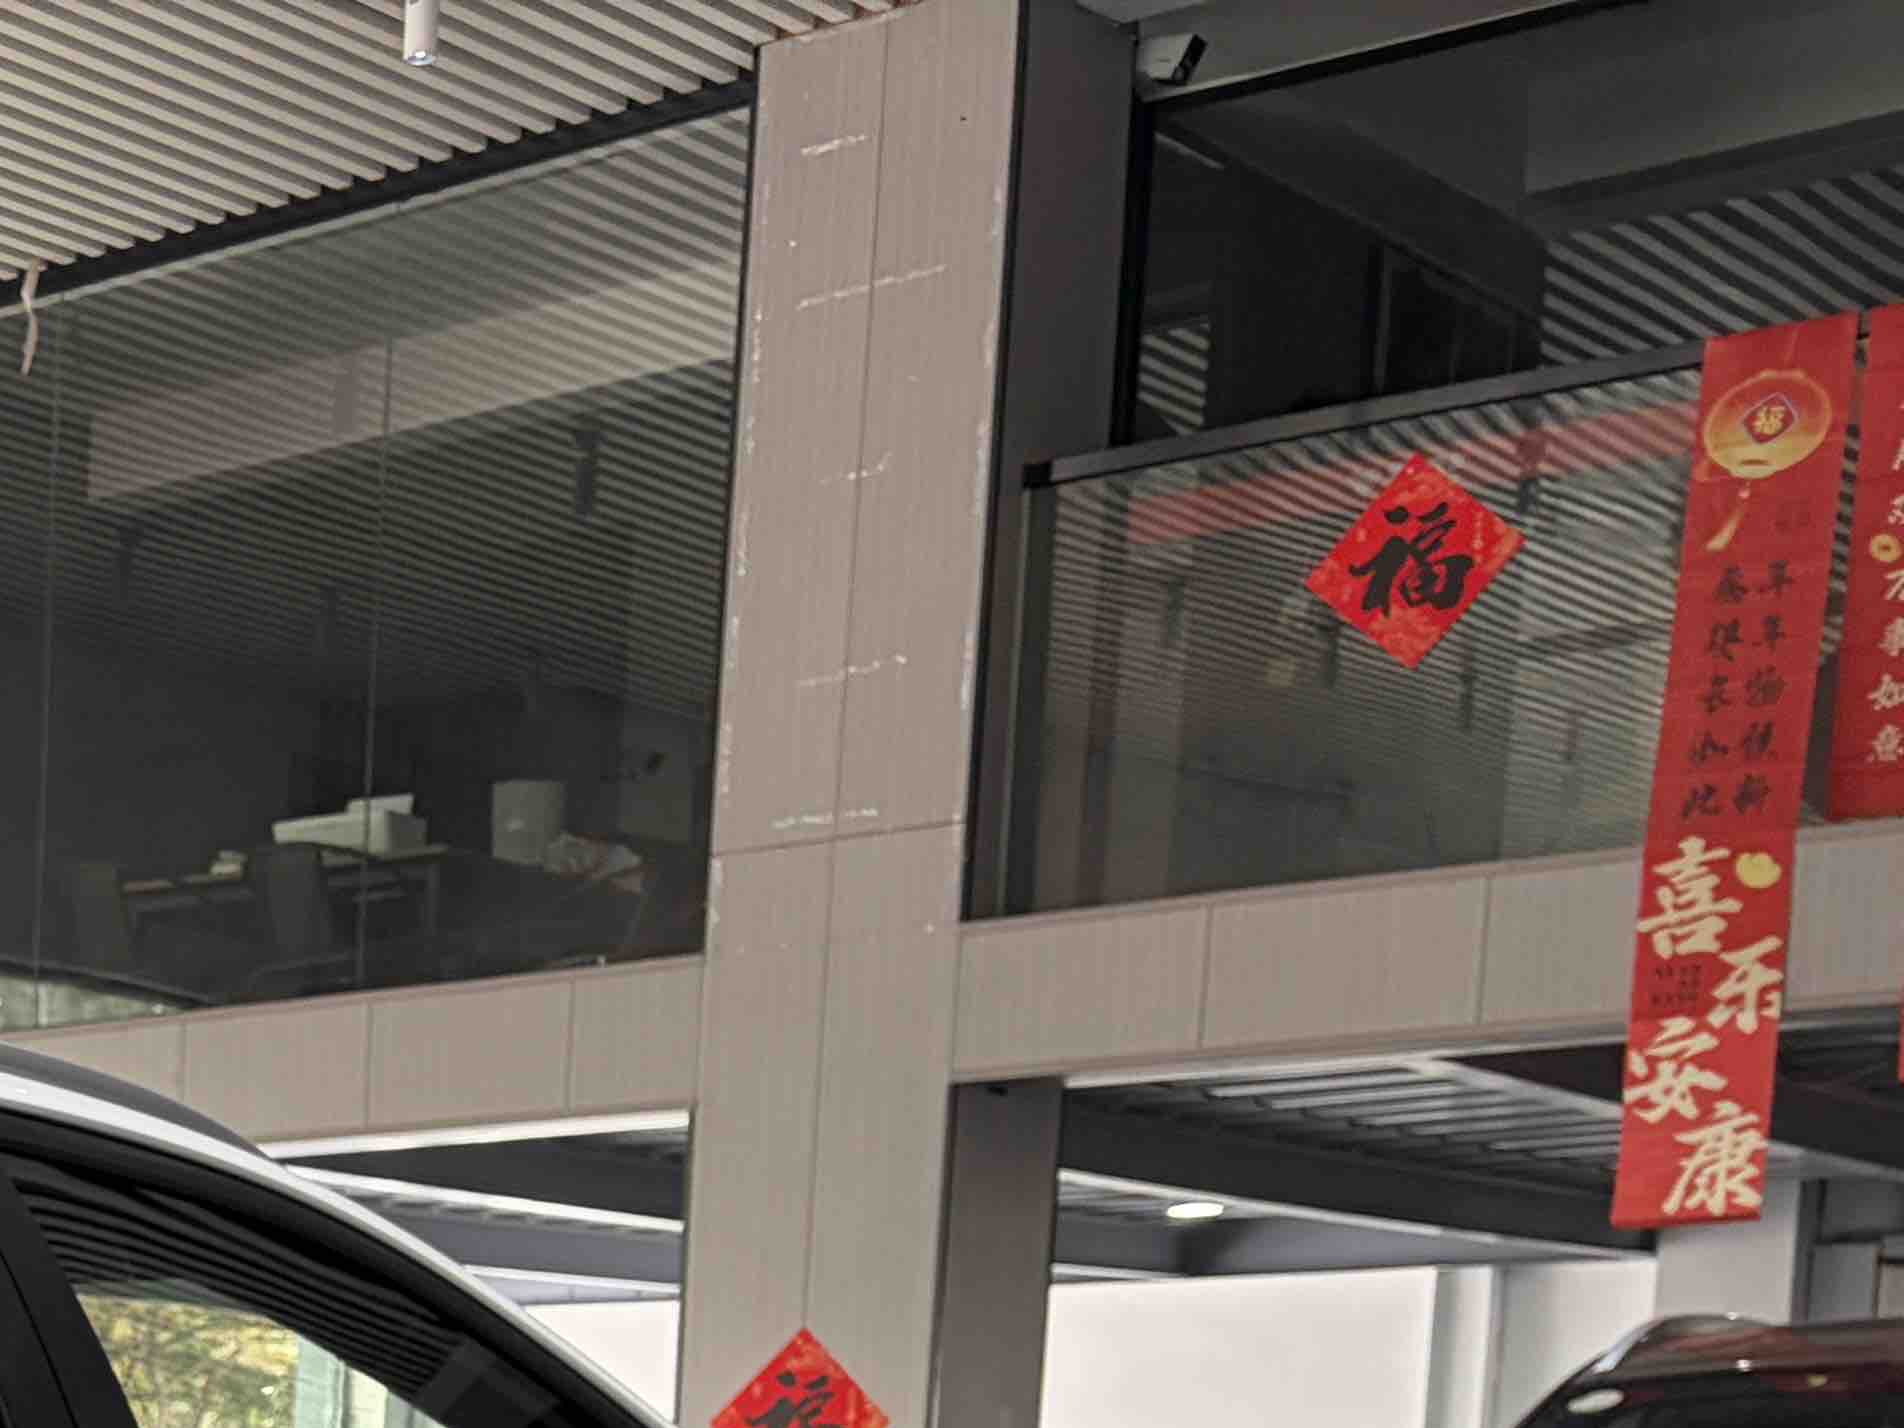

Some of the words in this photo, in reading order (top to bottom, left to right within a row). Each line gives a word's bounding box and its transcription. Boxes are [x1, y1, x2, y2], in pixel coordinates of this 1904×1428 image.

[1349, 502, 1476, 619] 福
[1624, 836, 1784, 1217] 喜乐安康
